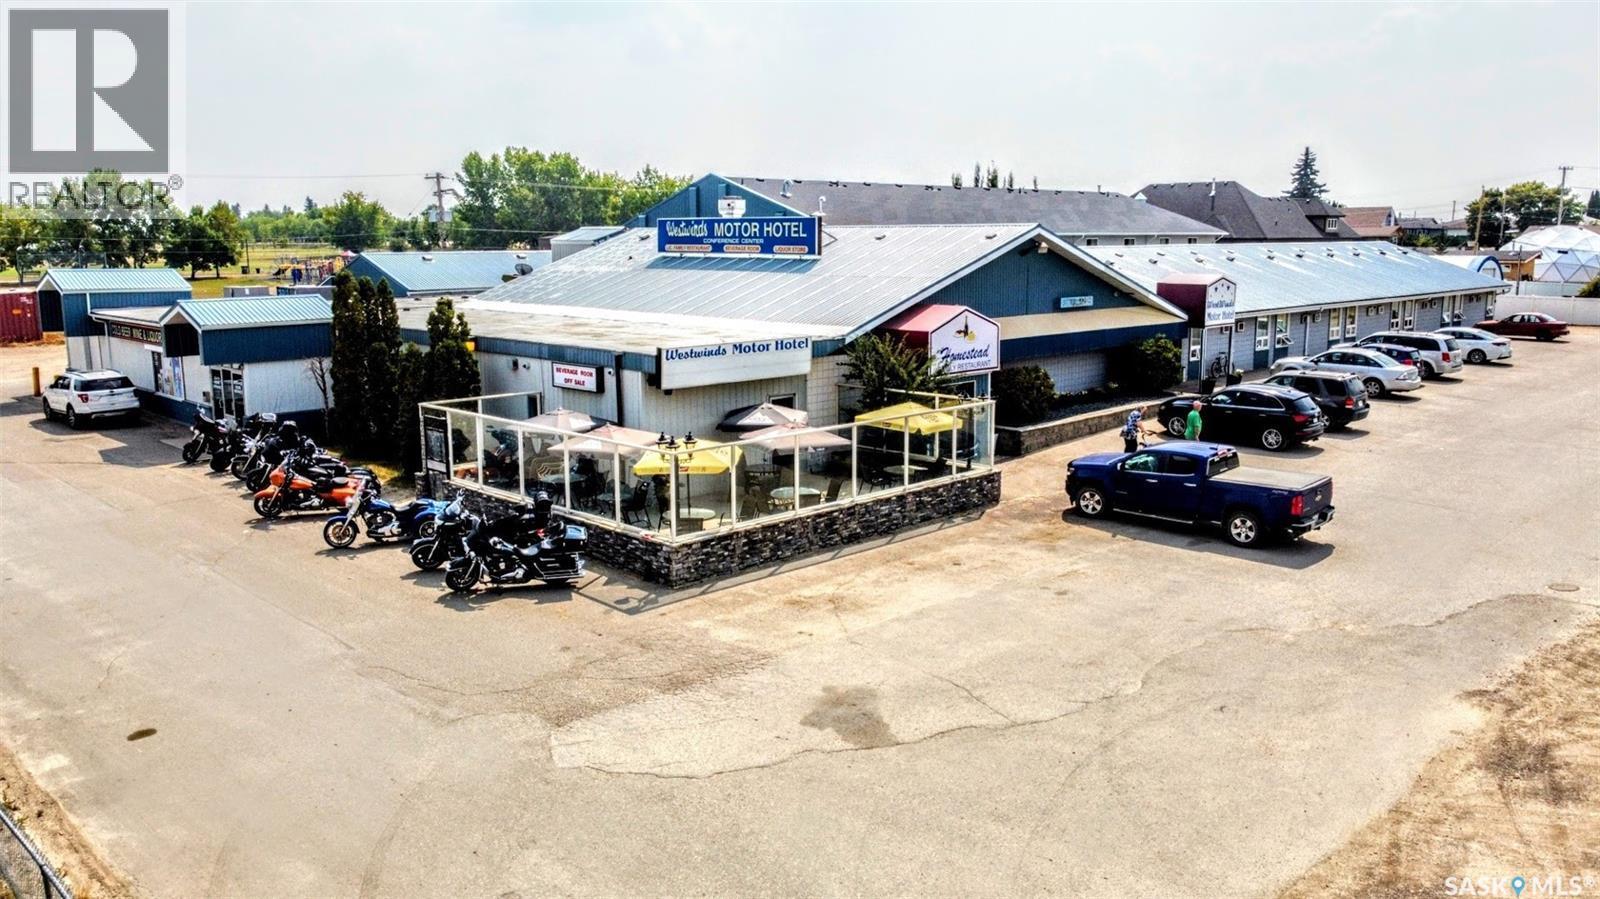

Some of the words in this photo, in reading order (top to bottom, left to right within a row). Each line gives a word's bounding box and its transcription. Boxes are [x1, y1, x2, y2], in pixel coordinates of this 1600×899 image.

[666, 220, 708, 237] Westwinds
[714, 222, 760, 237] MOTOR
[763, 222, 807, 237] HOTEL
[665, 345, 727, 361] Westwinds
[732, 340, 772, 354] Motor
[775, 338, 809, 350] Hotel
[556, 367, 578, 375] BEVERAGE
[957, 359, 991, 370] RESTAURANT
